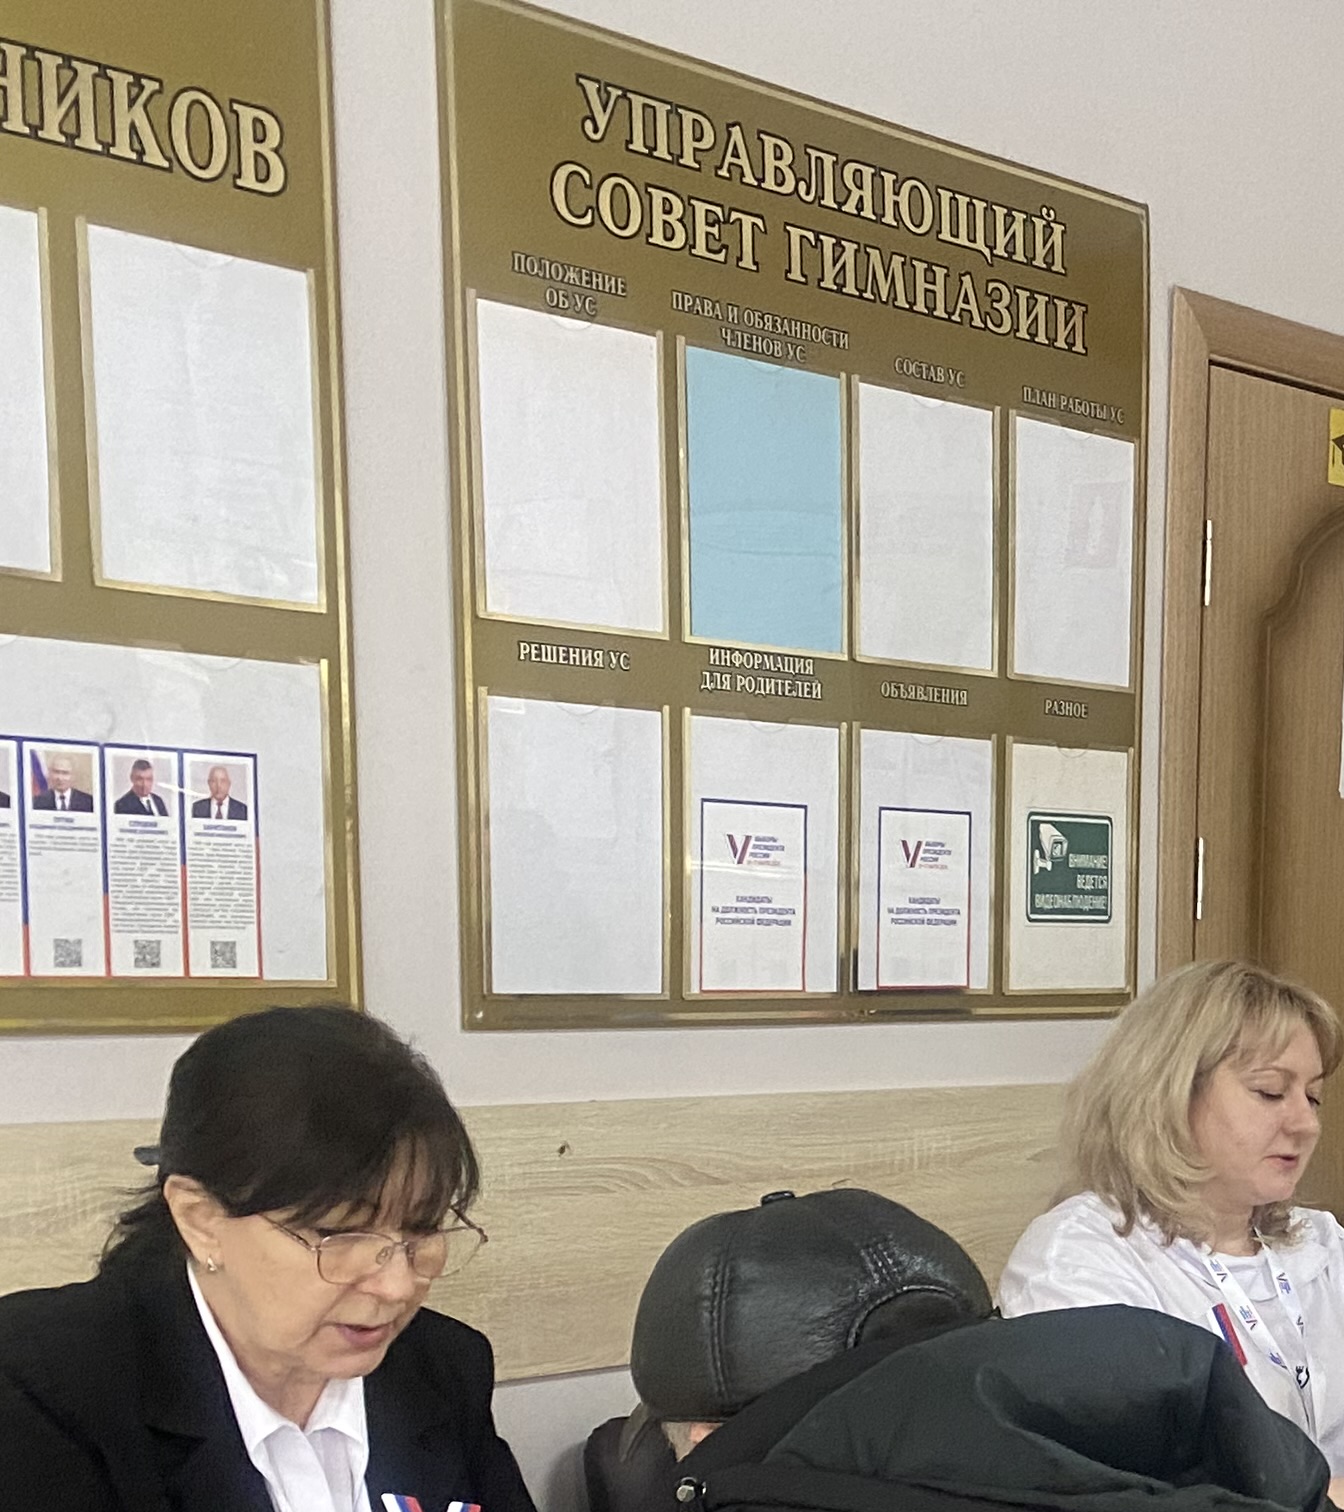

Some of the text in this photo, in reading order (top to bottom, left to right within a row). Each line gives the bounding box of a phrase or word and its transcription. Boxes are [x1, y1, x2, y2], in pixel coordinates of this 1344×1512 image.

[575, 73, 1068, 275] УПРАВЛЯЮЩИЙ
[550, 161, 1089, 355] СОВЕТ ГИМНАЗИИ
[512, 252, 627, 297] ПОЛОЖЕНИЕ
[544, 287, 597, 316] ОБ УС
[671, 290, 850, 350] ПРАВА И ОБЯЗАННОСТИ
[720, 327, 806, 363] ЧЛЕНОВ УС
[894, 357, 965, 388] СОСТАВ УС
[1022, 386, 1124, 424] ПЛАН РАБОТЫ УС
[517, 641, 631, 671] РЕШЕНИЯ УС
[708, 647, 815, 676] ИНФОРМАЦИЯ
[700, 671, 822, 700] ДЛЯ РОДИТЕЛЕЙ
[880, 680, 969, 706] ОБЪЯВЛЕНИЯ
[1044, 699, 1088, 719] РАЗНОЕ
